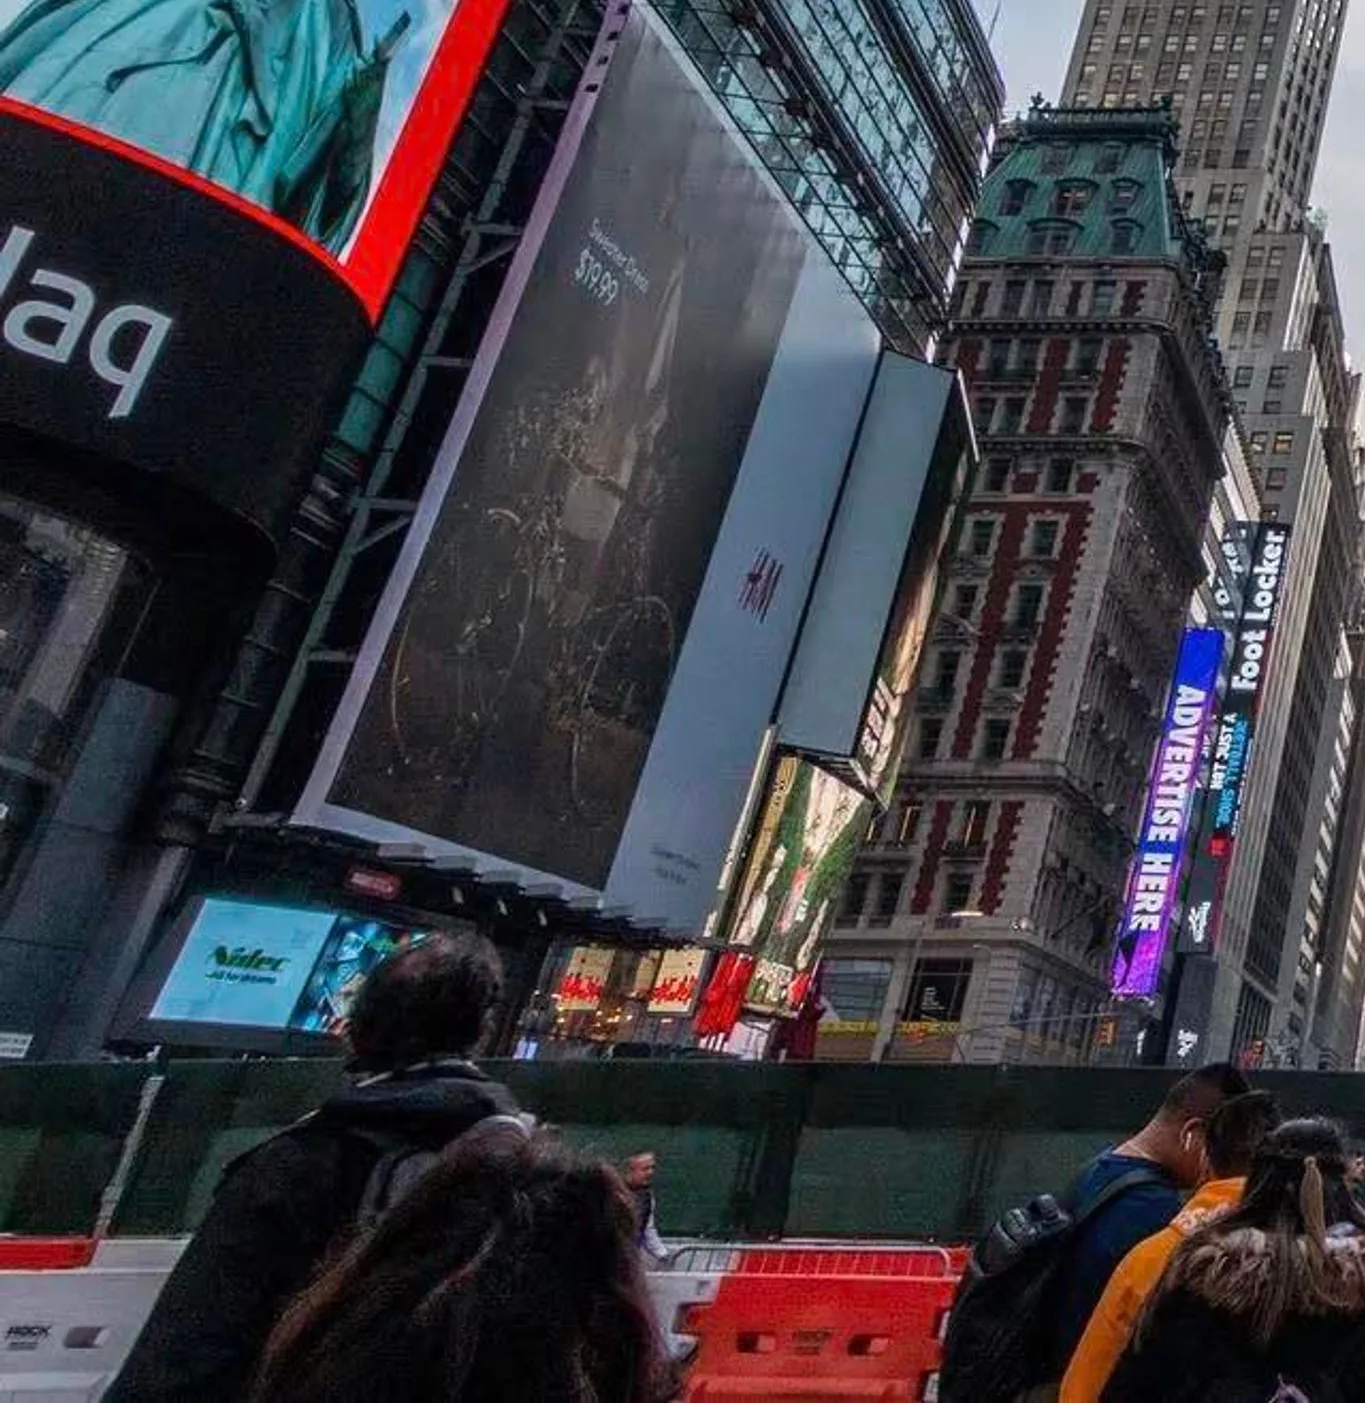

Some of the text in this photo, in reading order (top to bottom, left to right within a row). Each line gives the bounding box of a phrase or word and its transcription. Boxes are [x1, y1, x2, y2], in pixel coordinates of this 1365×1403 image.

[0, 225, 172, 419] aq
[1243, 530, 1286, 622] Locker
[1231, 629, 1267, 691] Foot
[1128, 684, 1206, 933] ADVERTISE HERE
[210, 944, 291, 972] Nidec
